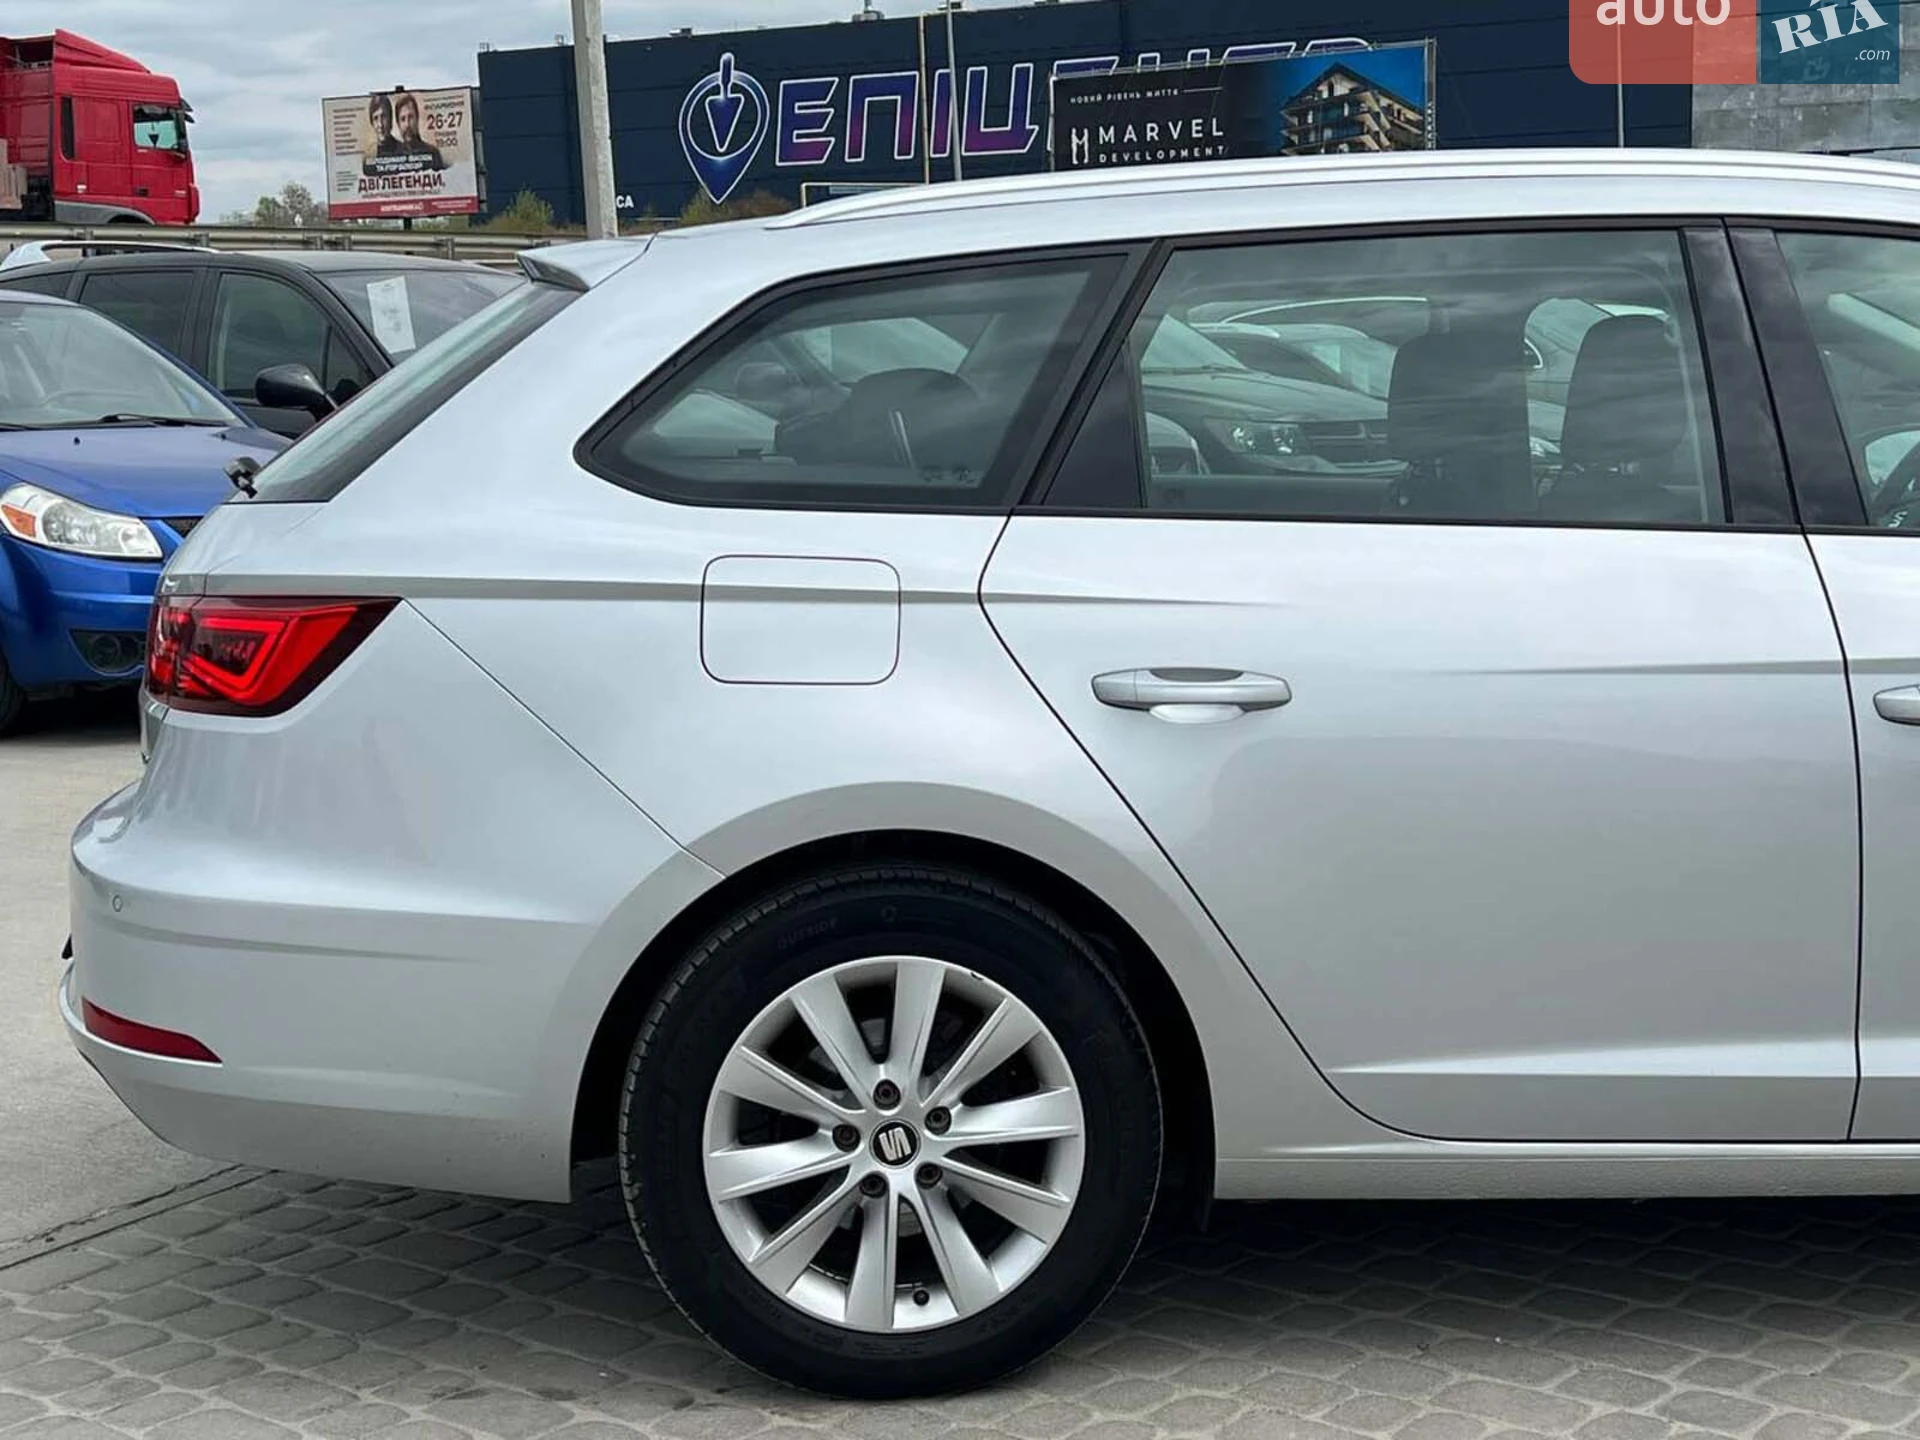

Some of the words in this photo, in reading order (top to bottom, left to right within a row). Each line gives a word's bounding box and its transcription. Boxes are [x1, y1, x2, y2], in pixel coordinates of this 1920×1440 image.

[1099, 117, 1224, 145] MARVEL
[1099, 145, 1224, 163] DEVELOPMENT
[358, 178, 380, 193] ДВІ
